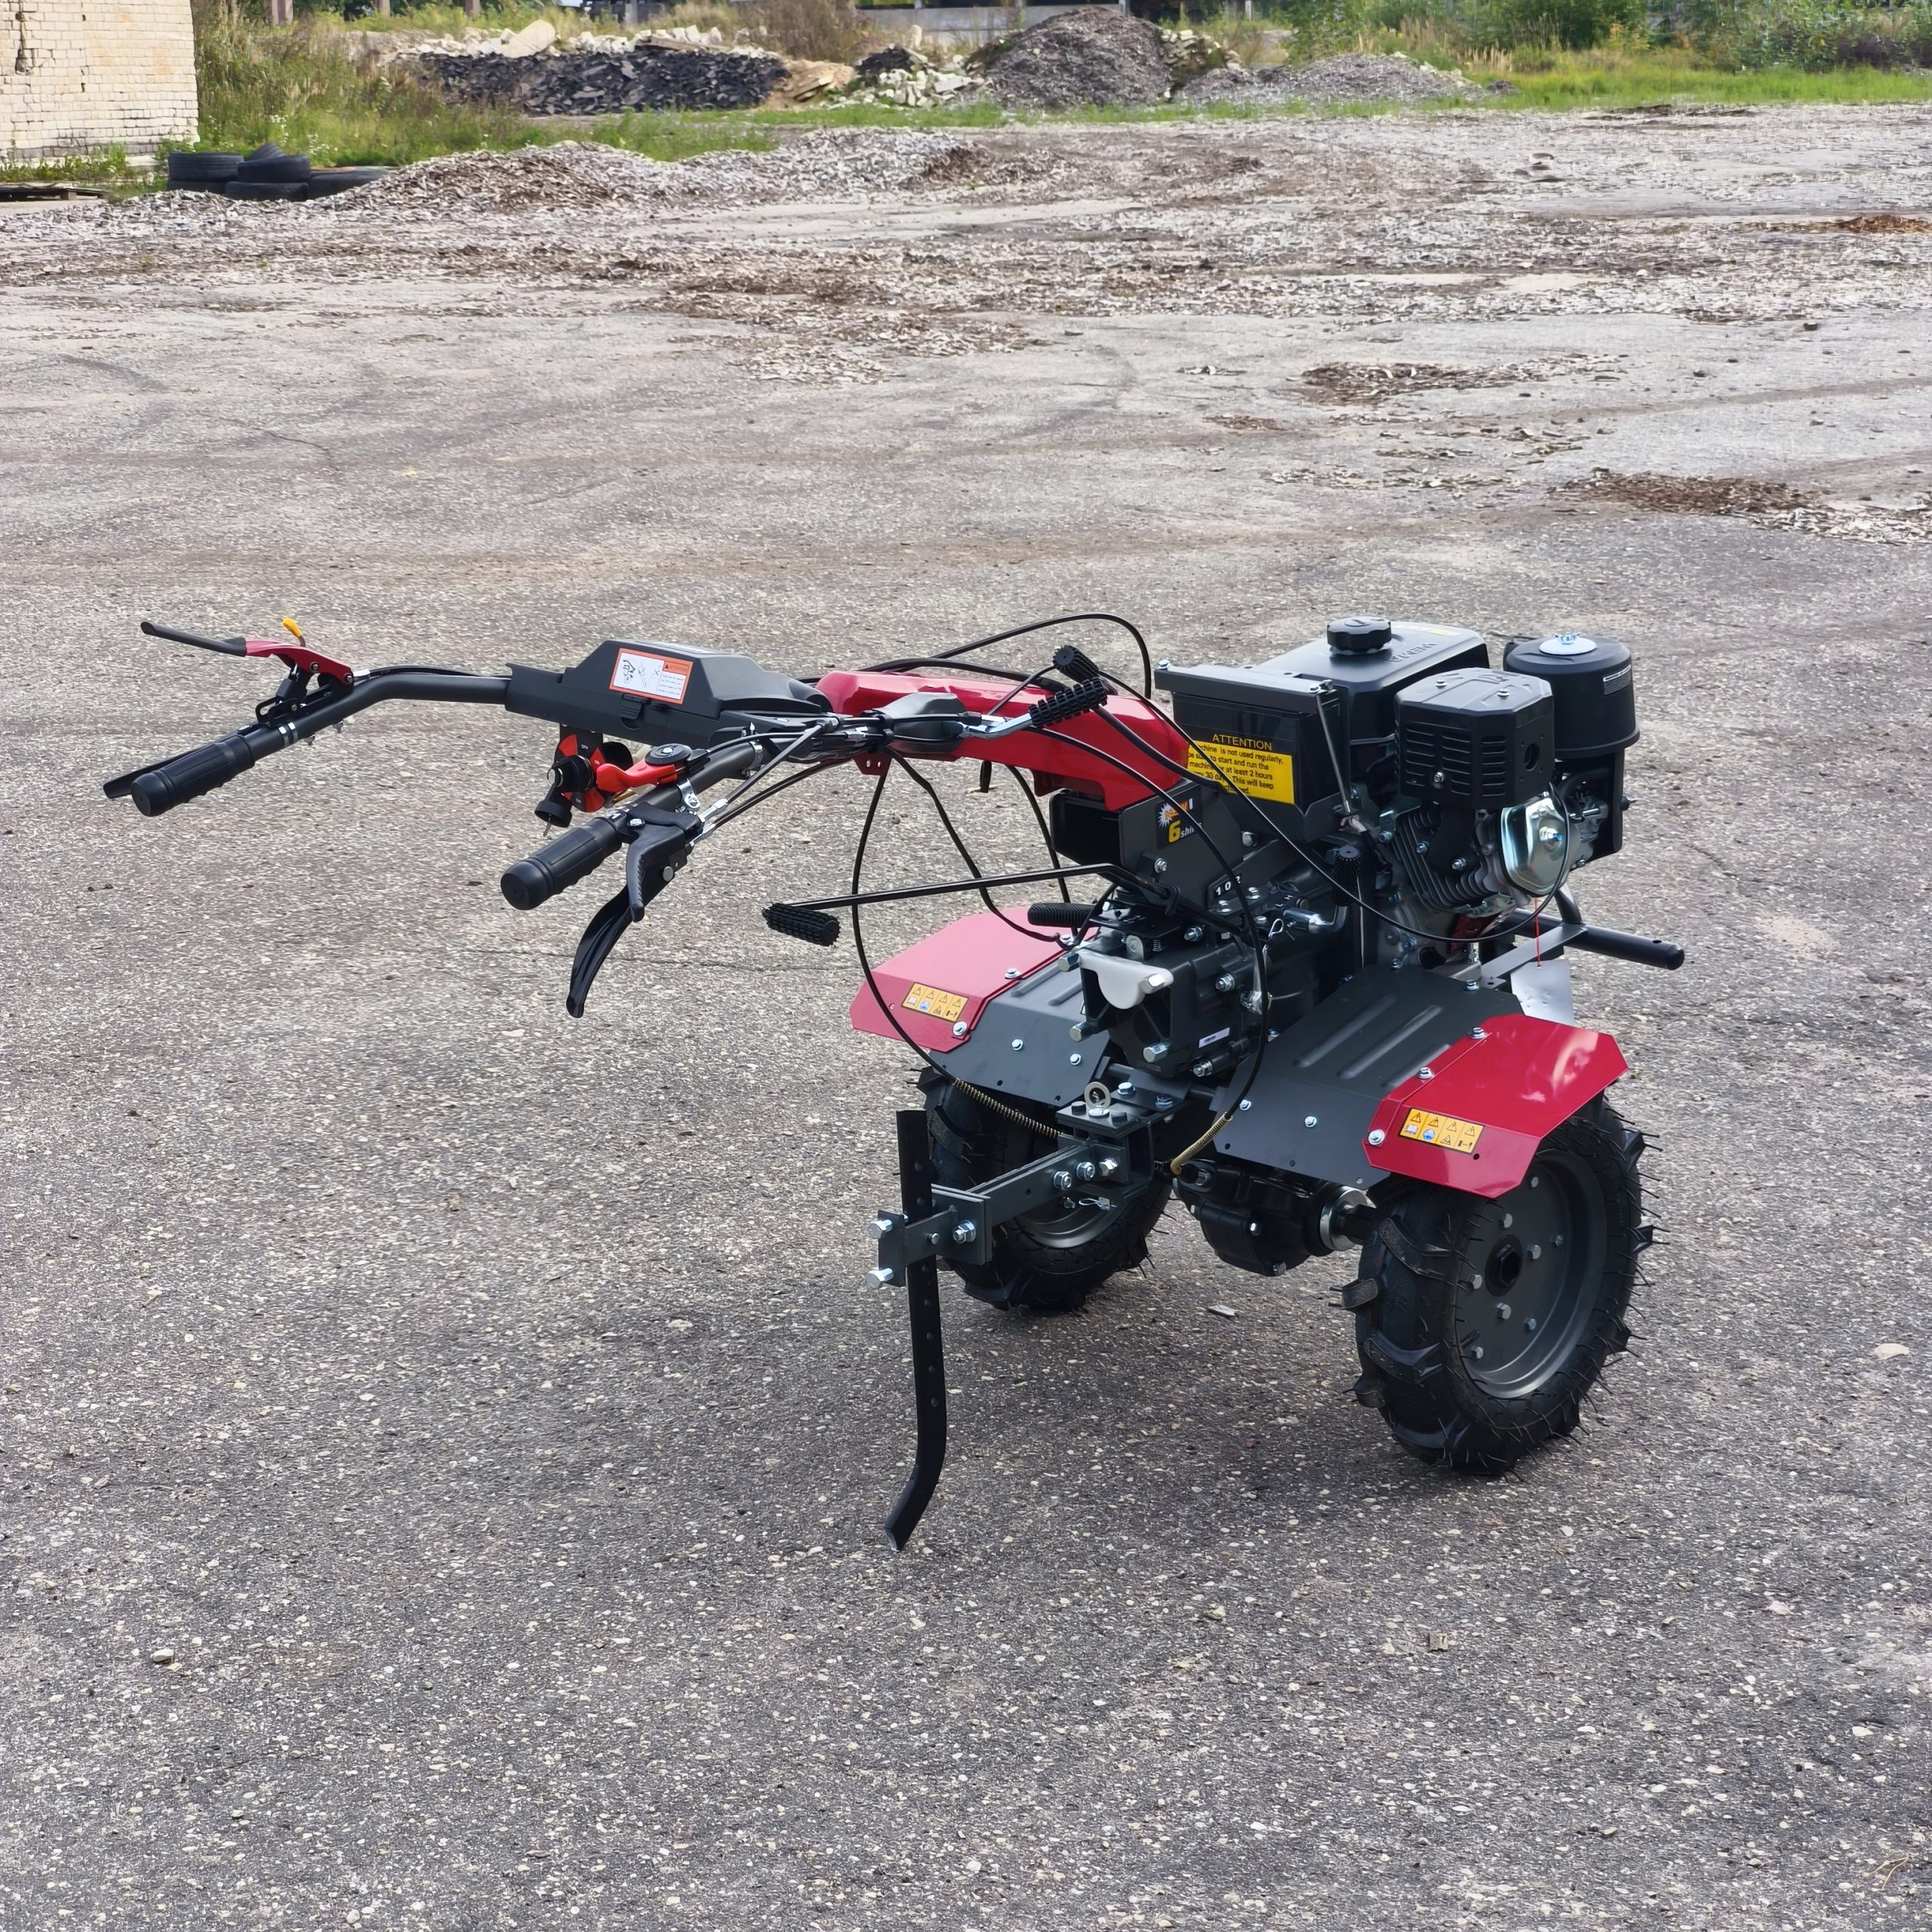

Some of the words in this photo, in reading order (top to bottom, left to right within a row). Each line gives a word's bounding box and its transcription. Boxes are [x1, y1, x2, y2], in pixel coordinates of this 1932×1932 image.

[1212, 734, 1272, 751] ATTENTION
[1220, 746, 1226, 755] is
[1238, 751, 1254, 759] used
[1217, 756, 1232, 764] start
[1258, 762, 1269, 771] the
[1233, 768, 1247, 776] least
[1255, 771, 1273, 780] hours
[1231, 775, 1245, 785] This
[1246, 779, 1258, 787] will
[1259, 780, 1274, 791] keep
